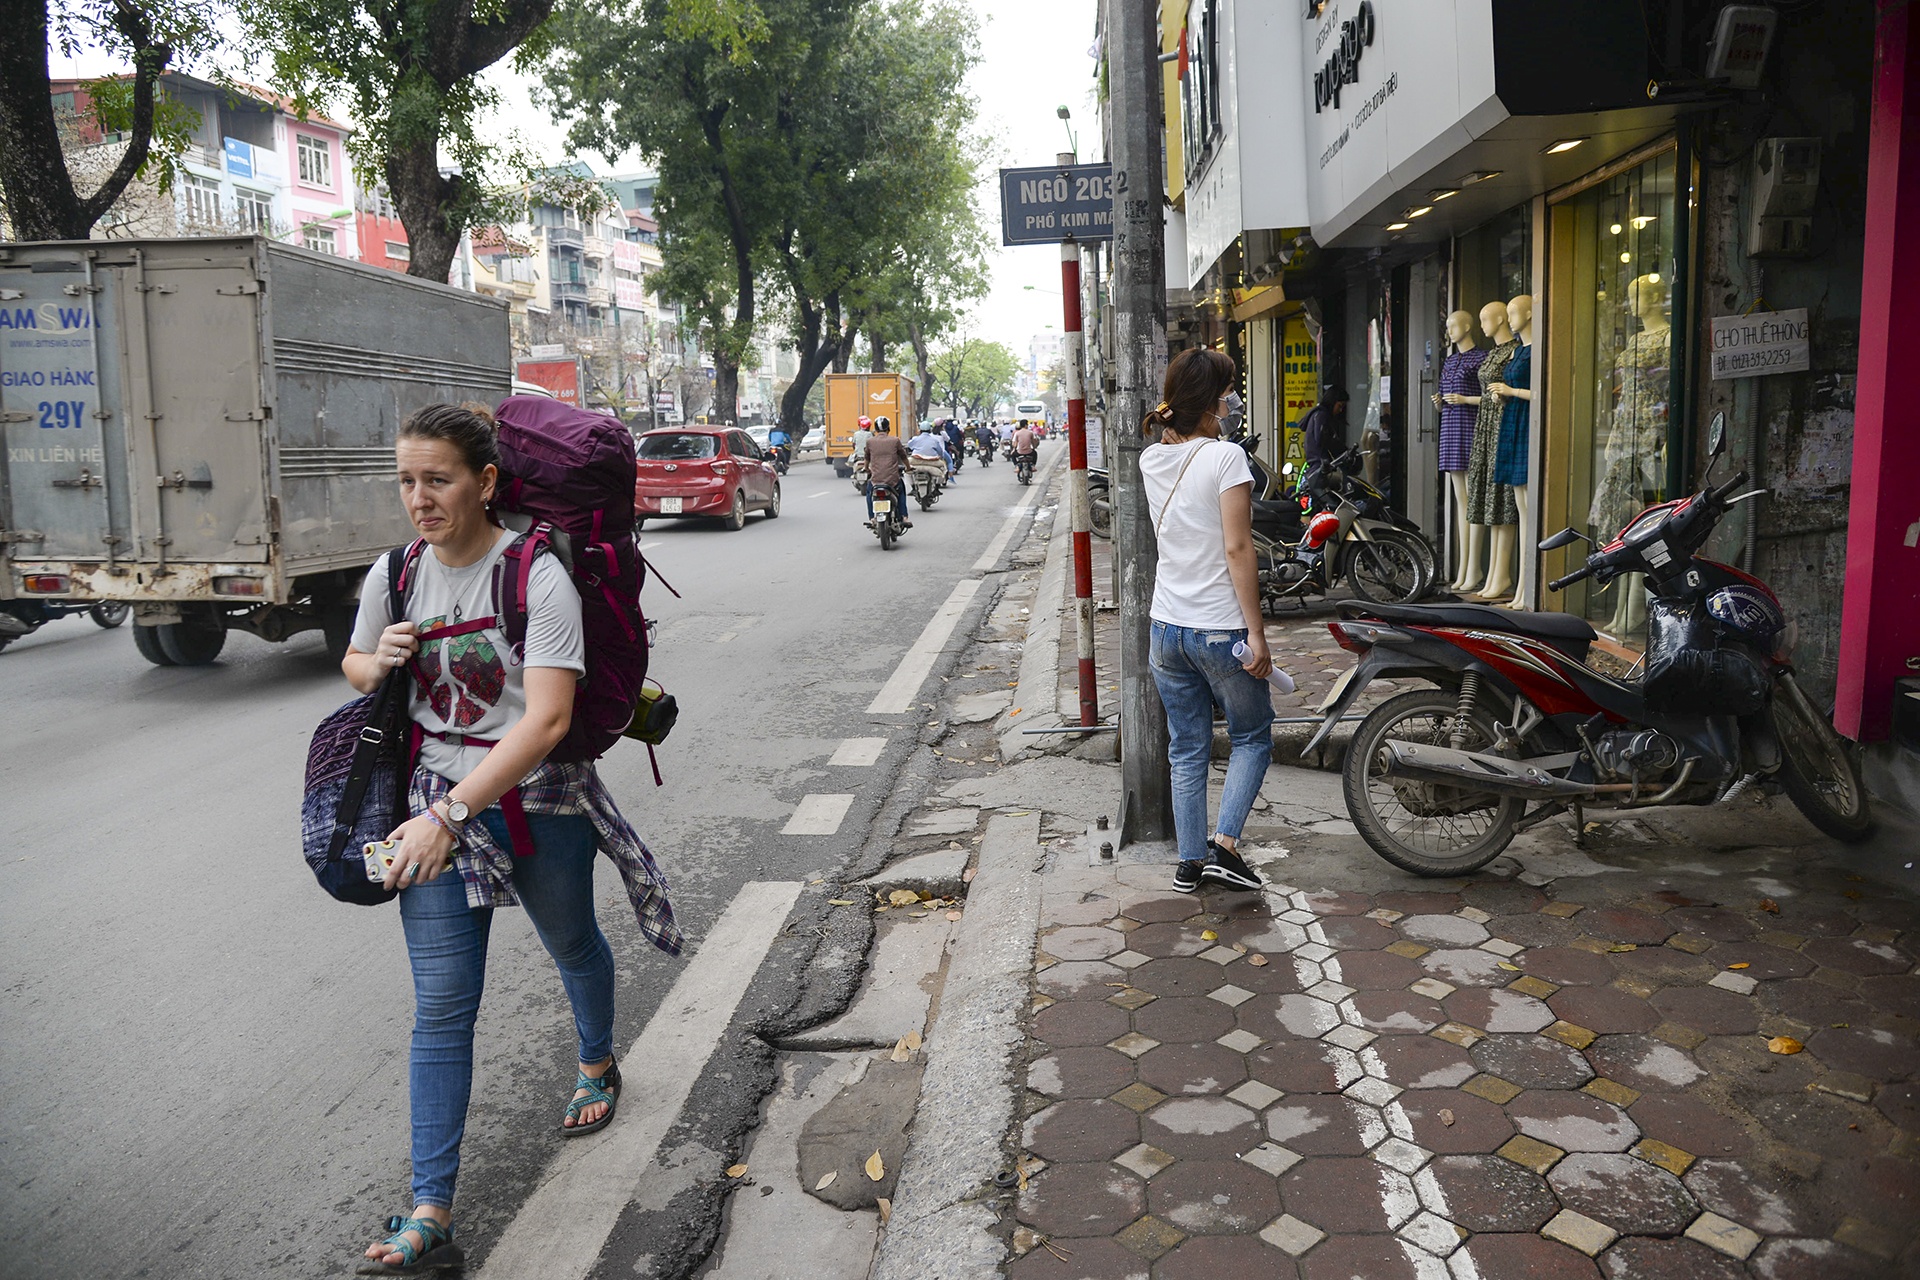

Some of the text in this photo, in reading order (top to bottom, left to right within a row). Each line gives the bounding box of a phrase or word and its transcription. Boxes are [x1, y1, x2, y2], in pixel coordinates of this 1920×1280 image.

[1025, 211, 1055, 229] PHỐ
[1061, 213, 1090, 227] KIM
[1714, 319, 1809, 348] CHO THUÊ PHÒNG
[1, 371, 45, 387] GIAO
[1288, 399, 1315, 409] BẠT
[38, 401, 85, 429] 29Y
[8, 448, 35, 463] XIN
[39, 444, 76, 463] LIÊN
